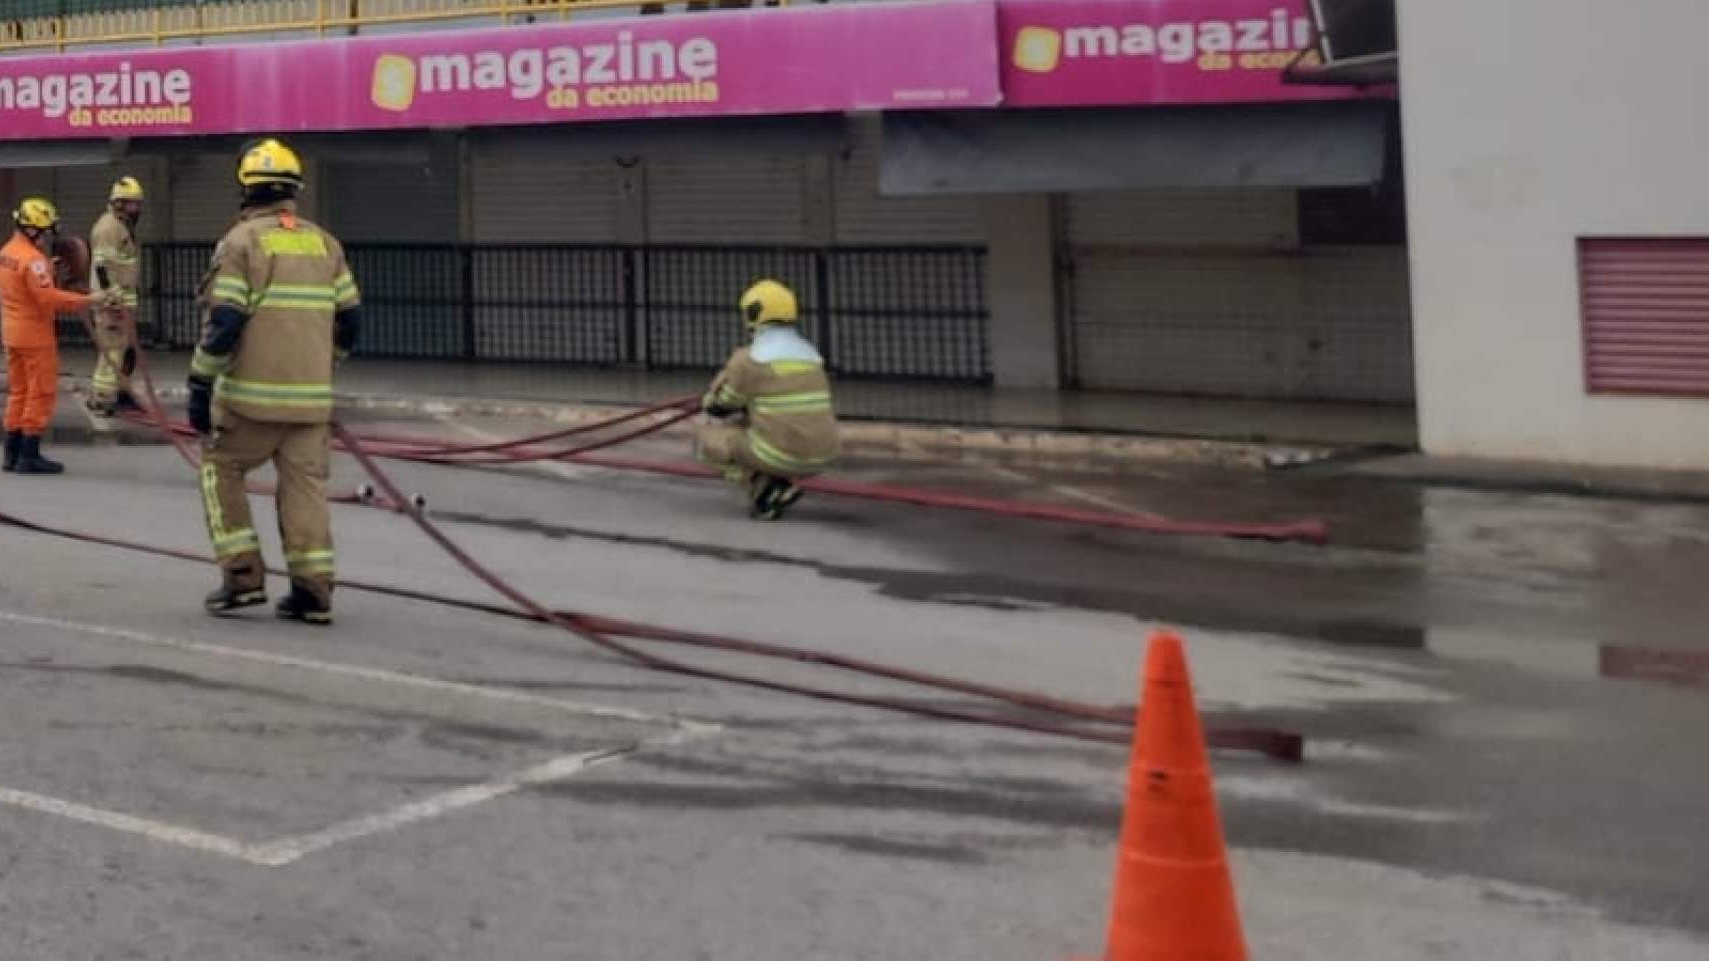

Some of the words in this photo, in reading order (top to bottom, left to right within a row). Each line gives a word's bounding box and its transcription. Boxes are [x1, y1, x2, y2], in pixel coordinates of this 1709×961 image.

[1063, 8, 1311, 64] magazi
[419, 30, 719, 100] magazine
[1196, 48, 1233, 72] da
[546, 81, 580, 110] da
[585, 76, 720, 108] economia
[67, 103, 92, 127] da
[97, 101, 193, 126] economia
